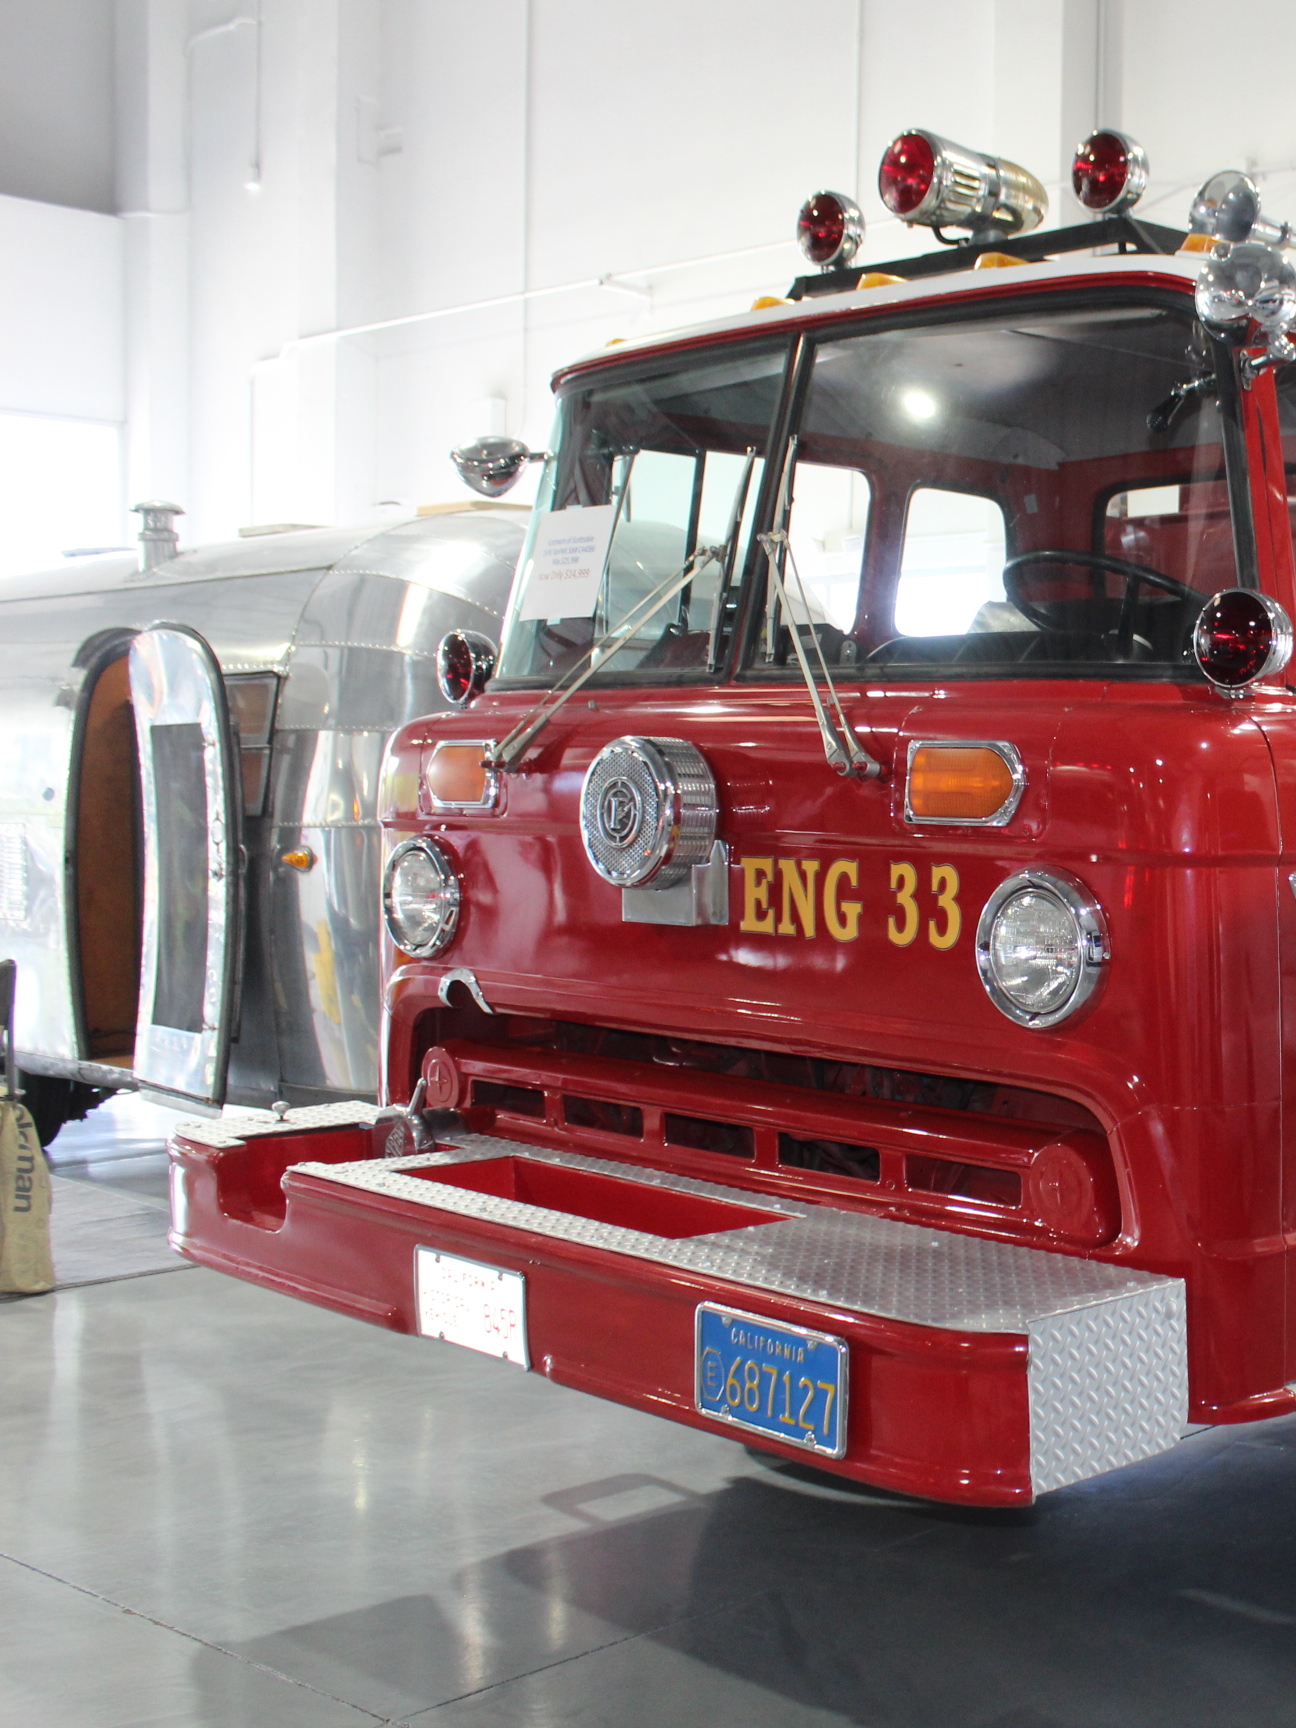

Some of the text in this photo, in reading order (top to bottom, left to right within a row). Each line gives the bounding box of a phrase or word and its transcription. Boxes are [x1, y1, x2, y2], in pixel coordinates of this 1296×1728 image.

[740, 856, 962, 951] ENG 33
[483, 1303, 518, 1342] 845R
[731, 1327, 805, 1363] CALIFORNIA
[726, 1356, 836, 1435] 687127
